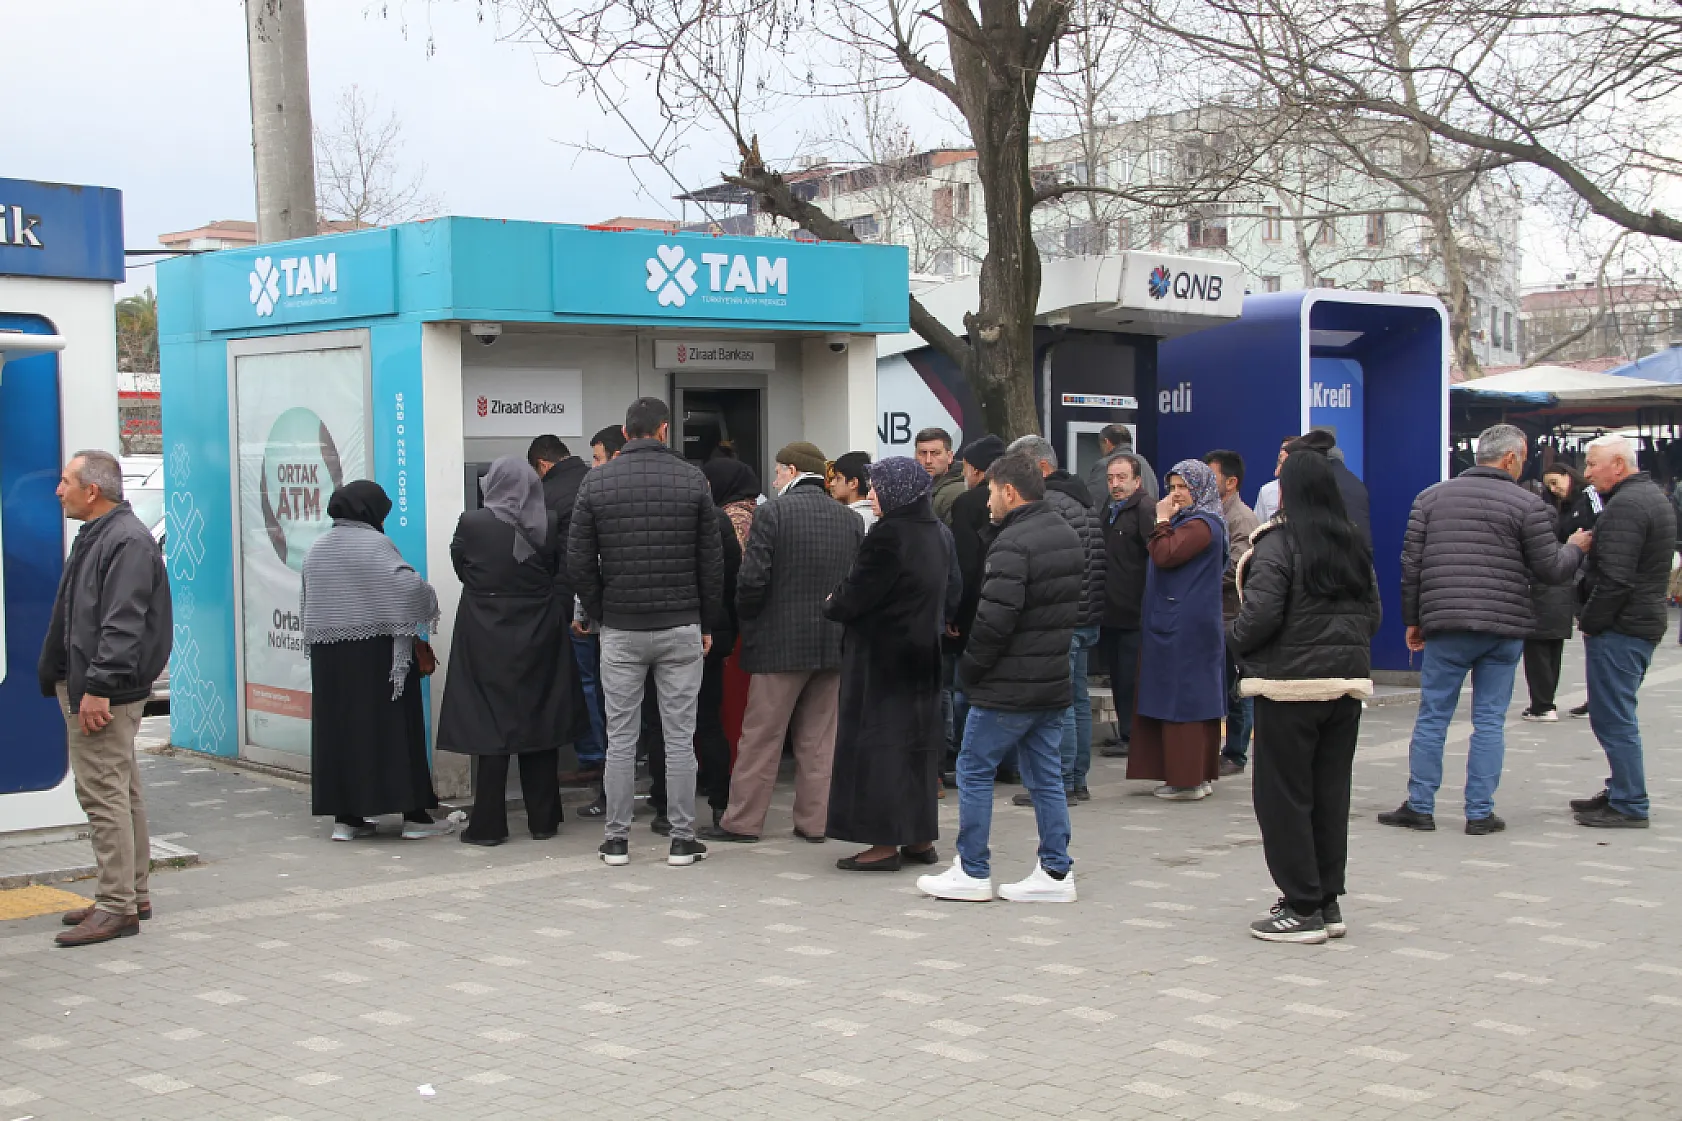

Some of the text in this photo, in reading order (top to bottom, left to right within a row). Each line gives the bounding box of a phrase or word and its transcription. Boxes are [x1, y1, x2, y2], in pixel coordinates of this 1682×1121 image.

[280, 252, 337, 297] TAM
[701, 252, 788, 295] TAM
[1174, 271, 1223, 301] QNB
[689, 347, 754, 362] Ziraat Bankası
[491, 399, 565, 414] Ziraat Bankası
[1158, 382, 1192, 414] edi
[877, 411, 912, 445] NB
[277, 463, 319, 485] ORTAK
[276, 486, 321, 522] ATM
[272, 608, 300, 632] Orta
